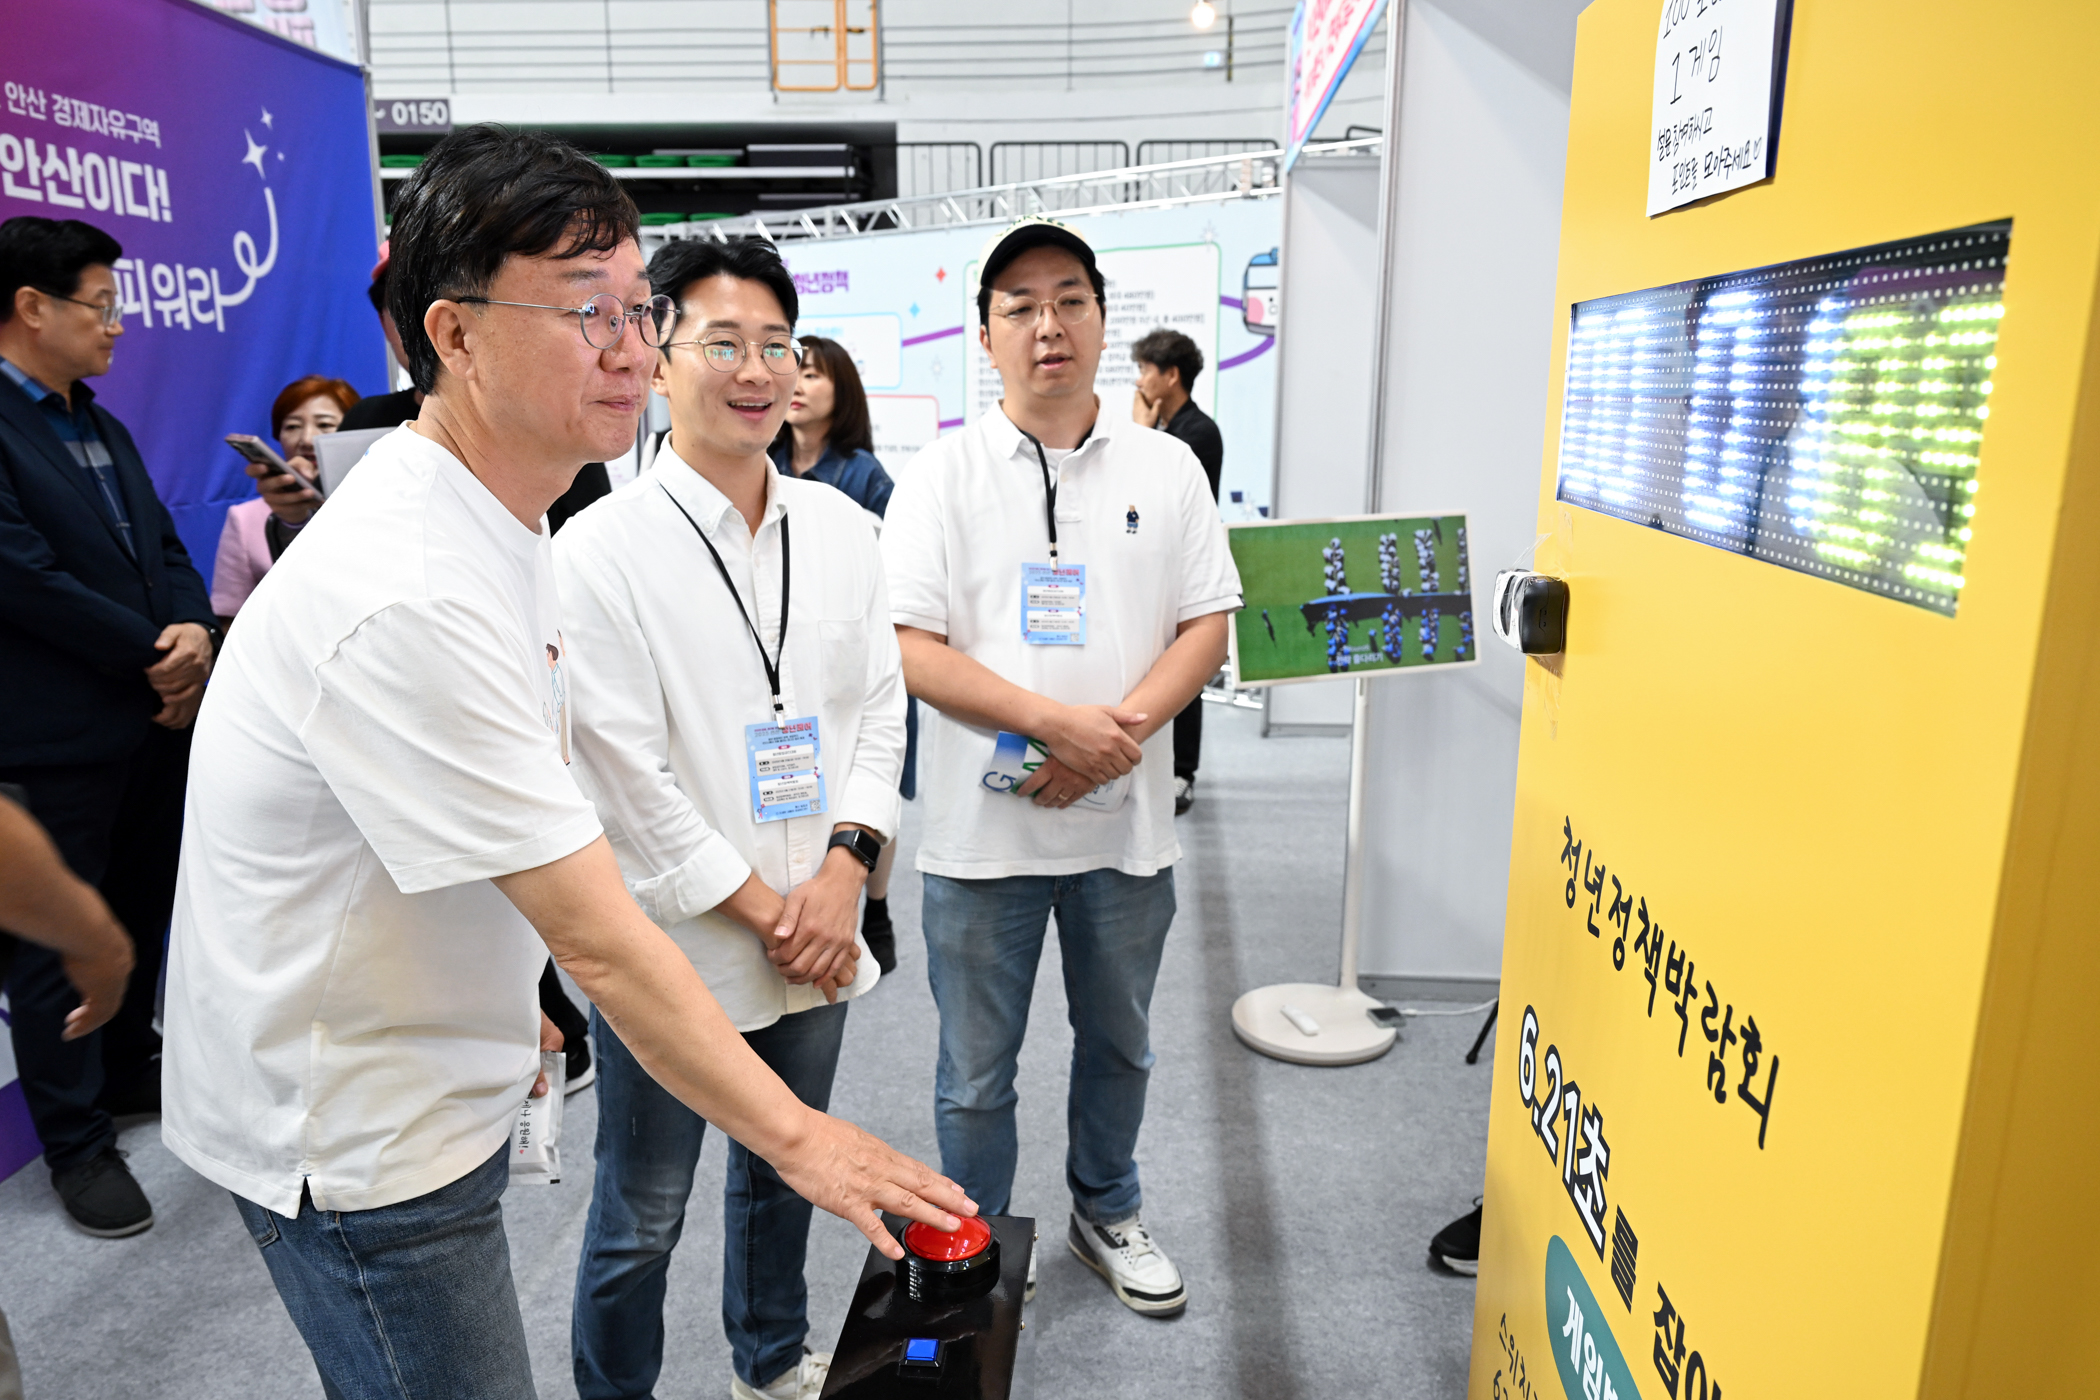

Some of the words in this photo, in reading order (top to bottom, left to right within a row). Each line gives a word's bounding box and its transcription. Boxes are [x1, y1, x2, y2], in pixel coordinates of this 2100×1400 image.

[1670, 52, 1682, 105] 1
[1689, 25, 1723, 83] 게임
[4, 81, 48, 121] 안산
[51, 93, 162, 149] 경제자유구역
[391, 101, 448, 126] 0150
[0, 133, 173, 223] 안산이다!
[112, 257, 226, 333] 피워라
[1561, 815, 1779, 1150] 청년정책박람회
[1562, 1285, 1619, 1400] 게임
